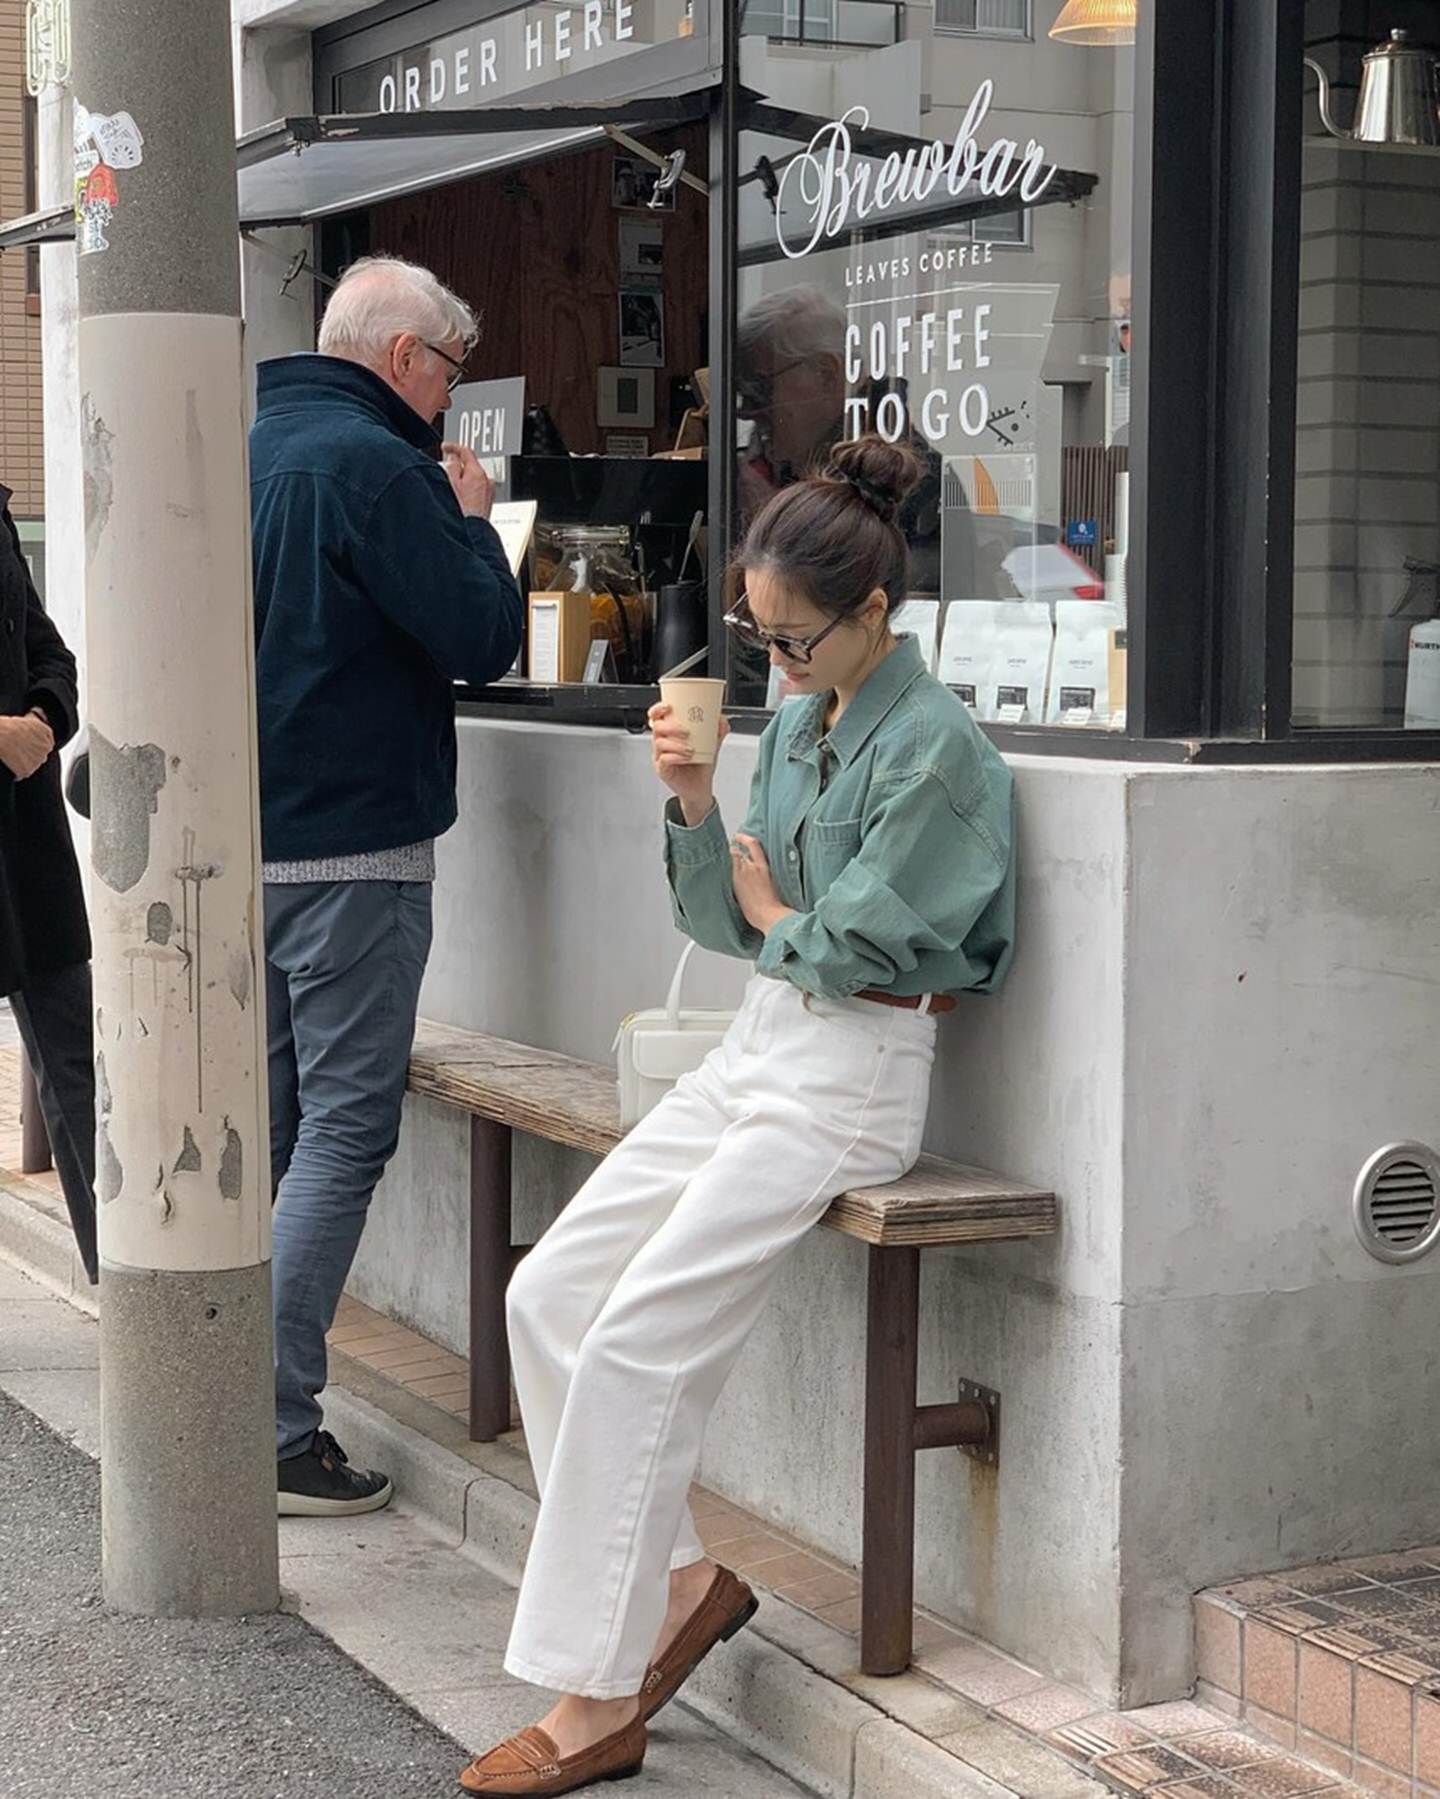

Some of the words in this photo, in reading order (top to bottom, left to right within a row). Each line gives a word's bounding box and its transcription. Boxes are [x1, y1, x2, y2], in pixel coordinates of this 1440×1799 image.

[380, 38, 497, 112] ORDER
[525, 0, 634, 71] HERE
[776, 79, 1057, 259] Brewbar
[845, 259, 910, 286] LEAVES
[919, 243, 993, 272] COFFEE
[845, 304, 991, 384] COFFEE
[459, 407, 505, 452] OPEN
[845, 393, 905, 443] TO
[922, 384, 989, 440] GO
